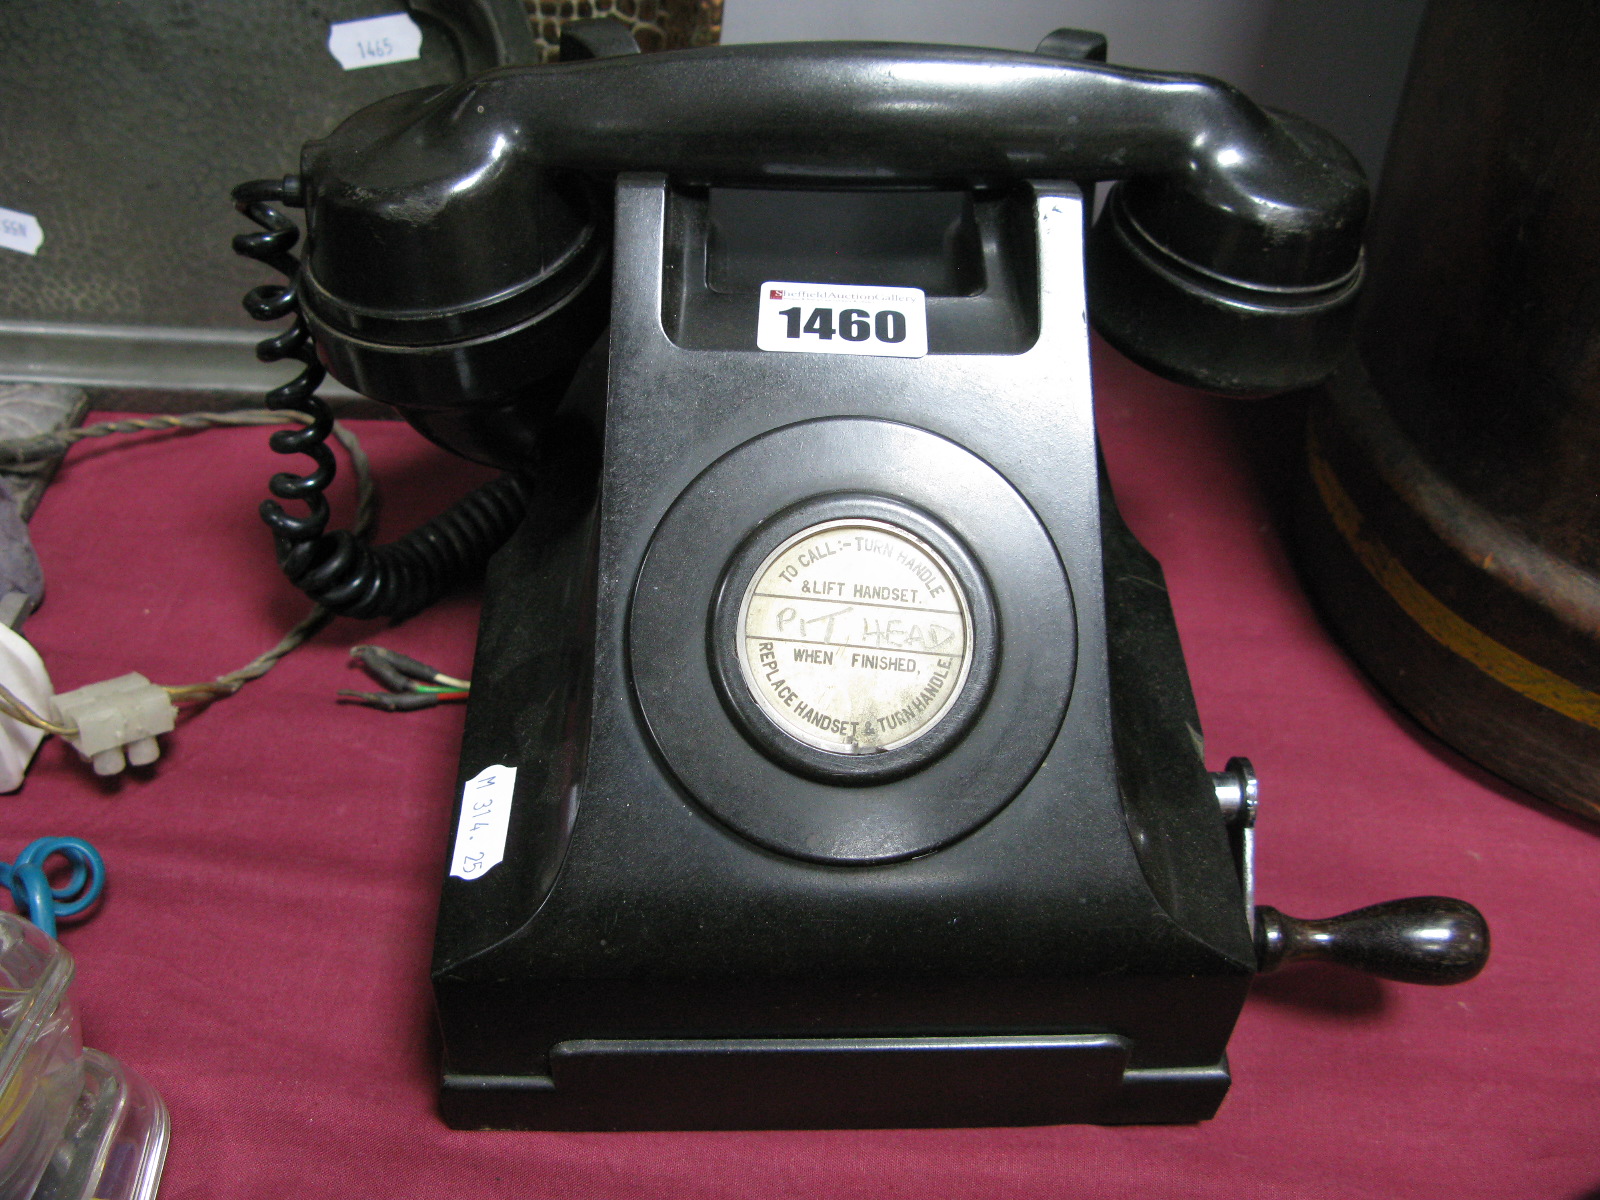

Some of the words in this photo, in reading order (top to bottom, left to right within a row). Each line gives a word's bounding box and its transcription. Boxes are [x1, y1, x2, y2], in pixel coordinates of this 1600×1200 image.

[357, 37, 393, 58] 1465
[779, 307, 906, 343] 1460
[779, 564, 798, 584] TO
[855, 537, 894, 558] TURN
[896, 552, 945, 599] HANDLE
[854, 583, 921, 604] HANDSET.
[862, 618, 955, 649] HEAD
[793, 648, 833, 666] WHEN
[851, 653, 920, 675] FINISHED,
[759, 642, 797, 707] REPLACE
[794, 701, 859, 736] HANDSET
[864, 722, 876, 736] &
[877, 708, 915, 733] TURN
[476, 775, 496, 789] M
[463, 852, 484, 873] 25
